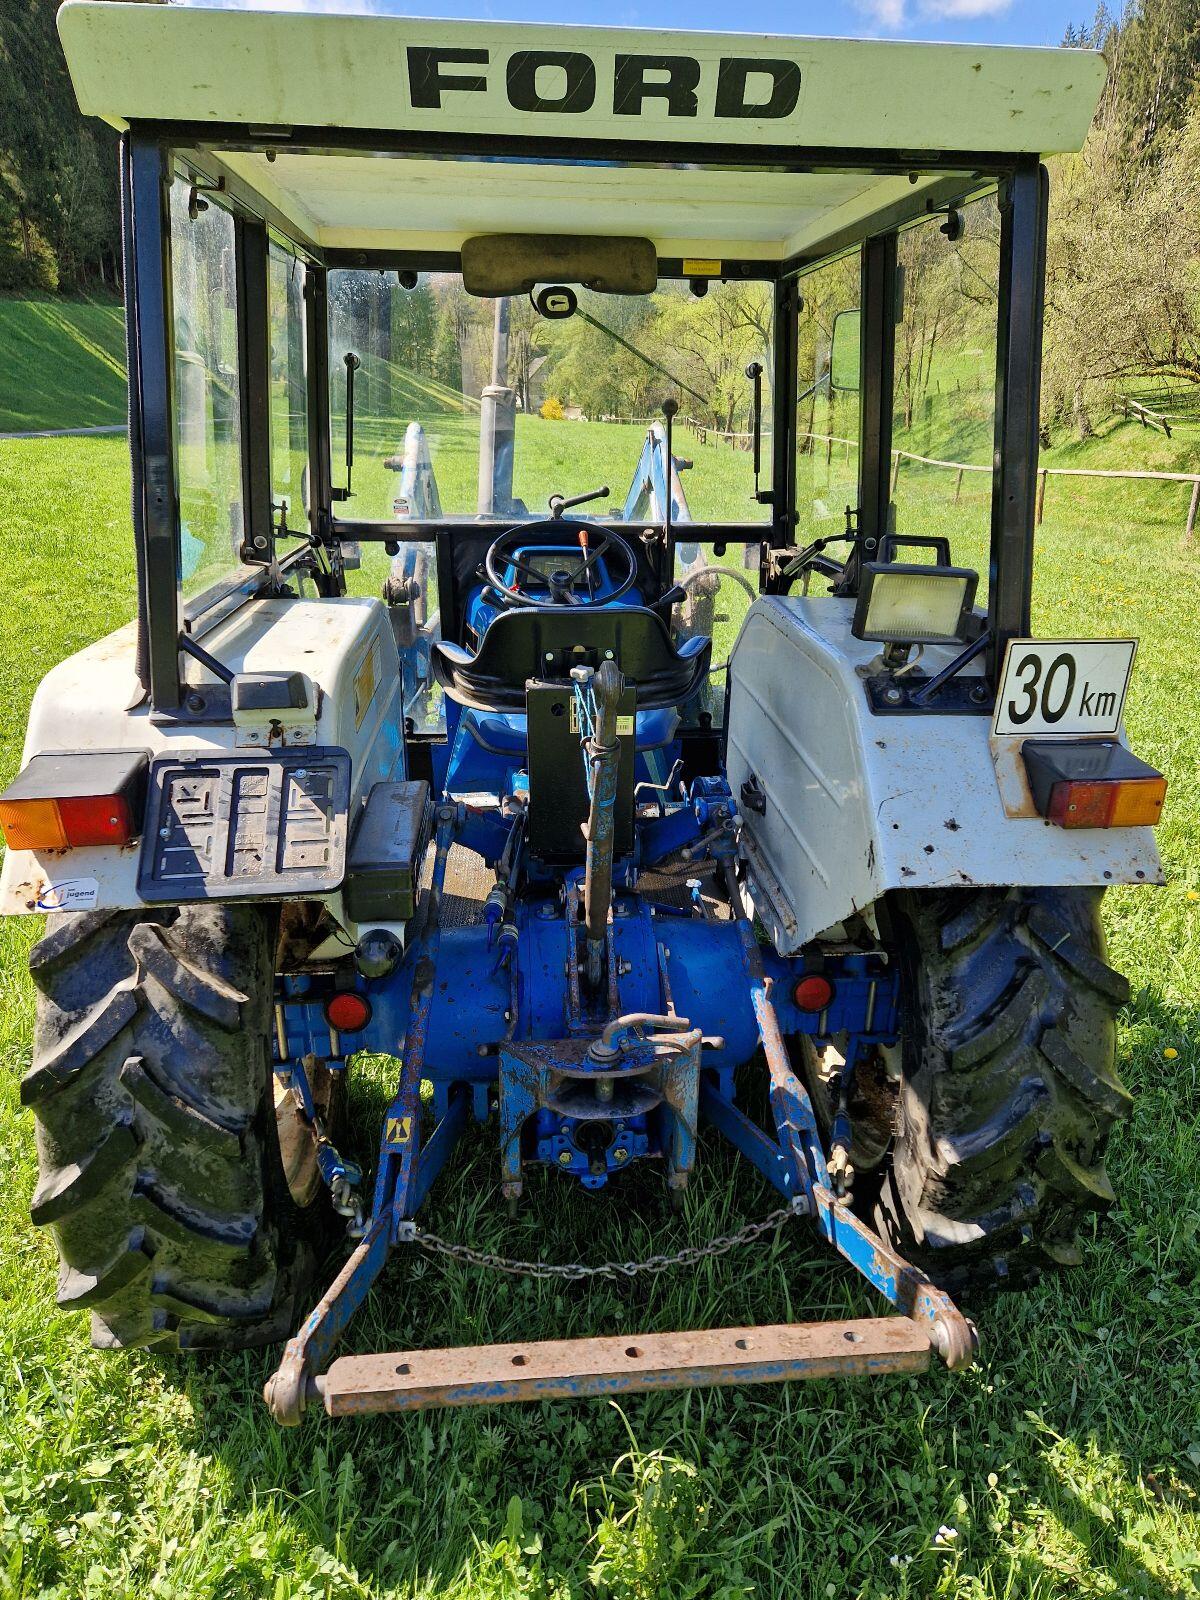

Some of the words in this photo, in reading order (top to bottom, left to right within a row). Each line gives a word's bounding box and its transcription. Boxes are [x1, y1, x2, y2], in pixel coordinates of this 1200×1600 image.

[406, 46, 801, 119] FORD
[1008, 652, 1077, 725] 30
[1079, 681, 1117, 717] km
[66, 889, 95, 899] jugend
